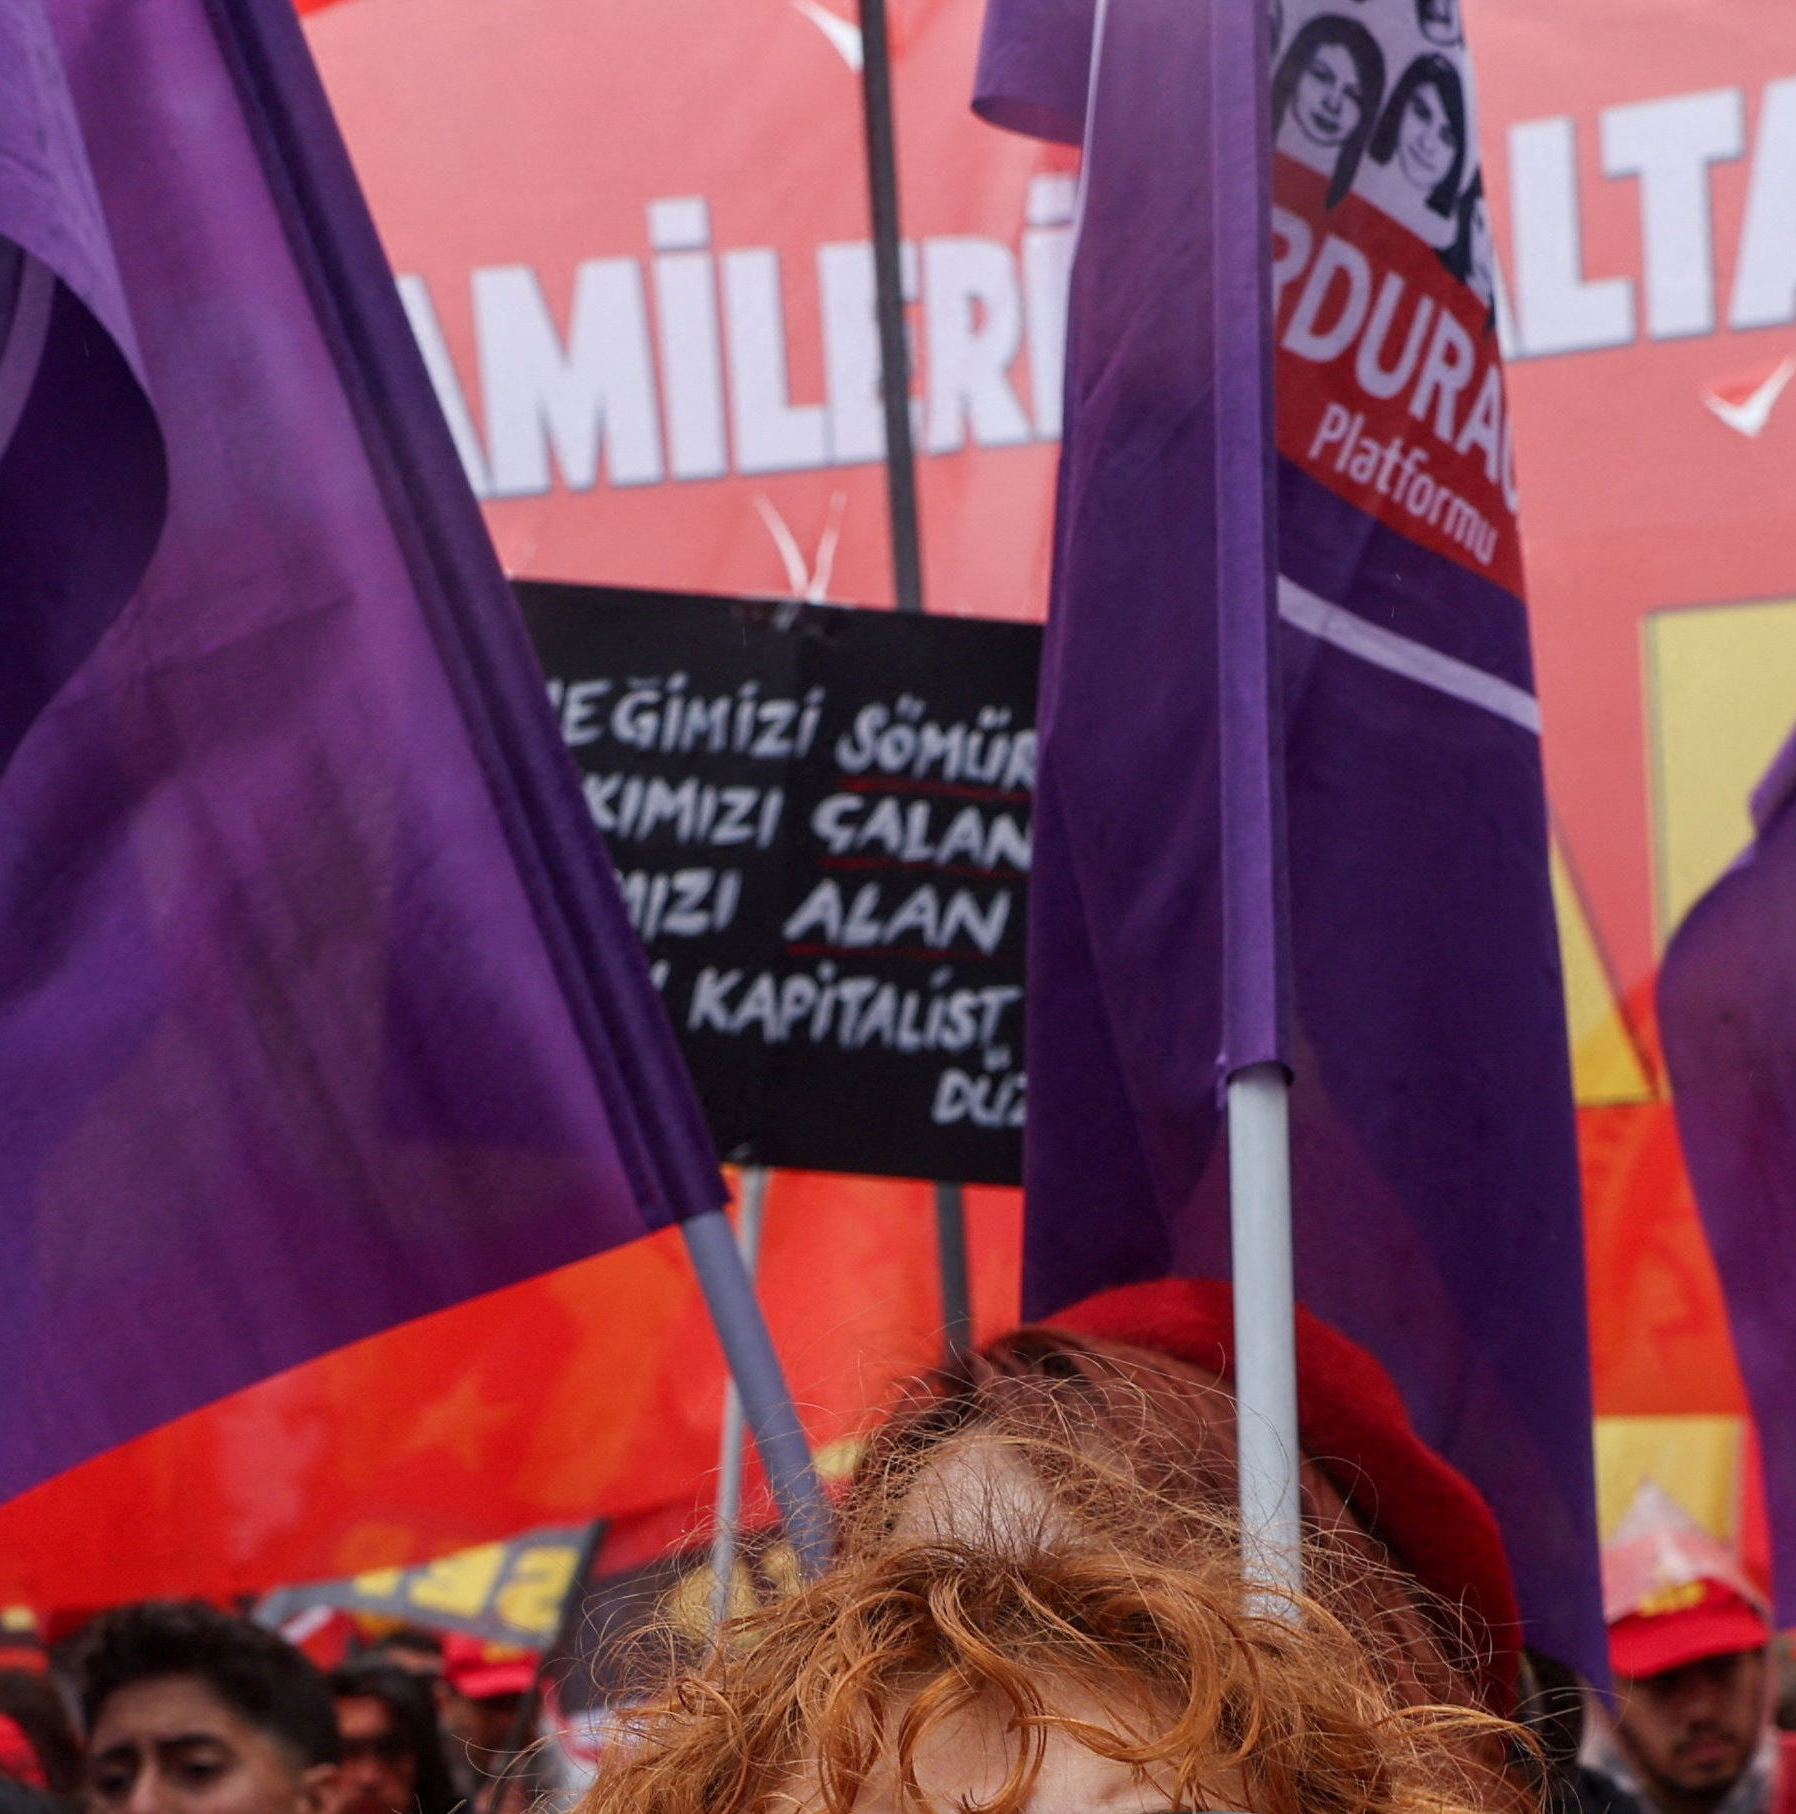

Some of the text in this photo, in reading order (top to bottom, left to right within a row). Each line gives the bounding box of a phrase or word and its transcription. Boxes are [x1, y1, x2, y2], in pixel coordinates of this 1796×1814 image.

[1308, 402, 1500, 566] Platformu
[547, 668, 825, 759] EĞİMİZİ
[811, 792, 1035, 872] ÇALAN
[783, 877, 1011, 955] ALAN
[688, 959, 1024, 1053] KAPİTALİST
